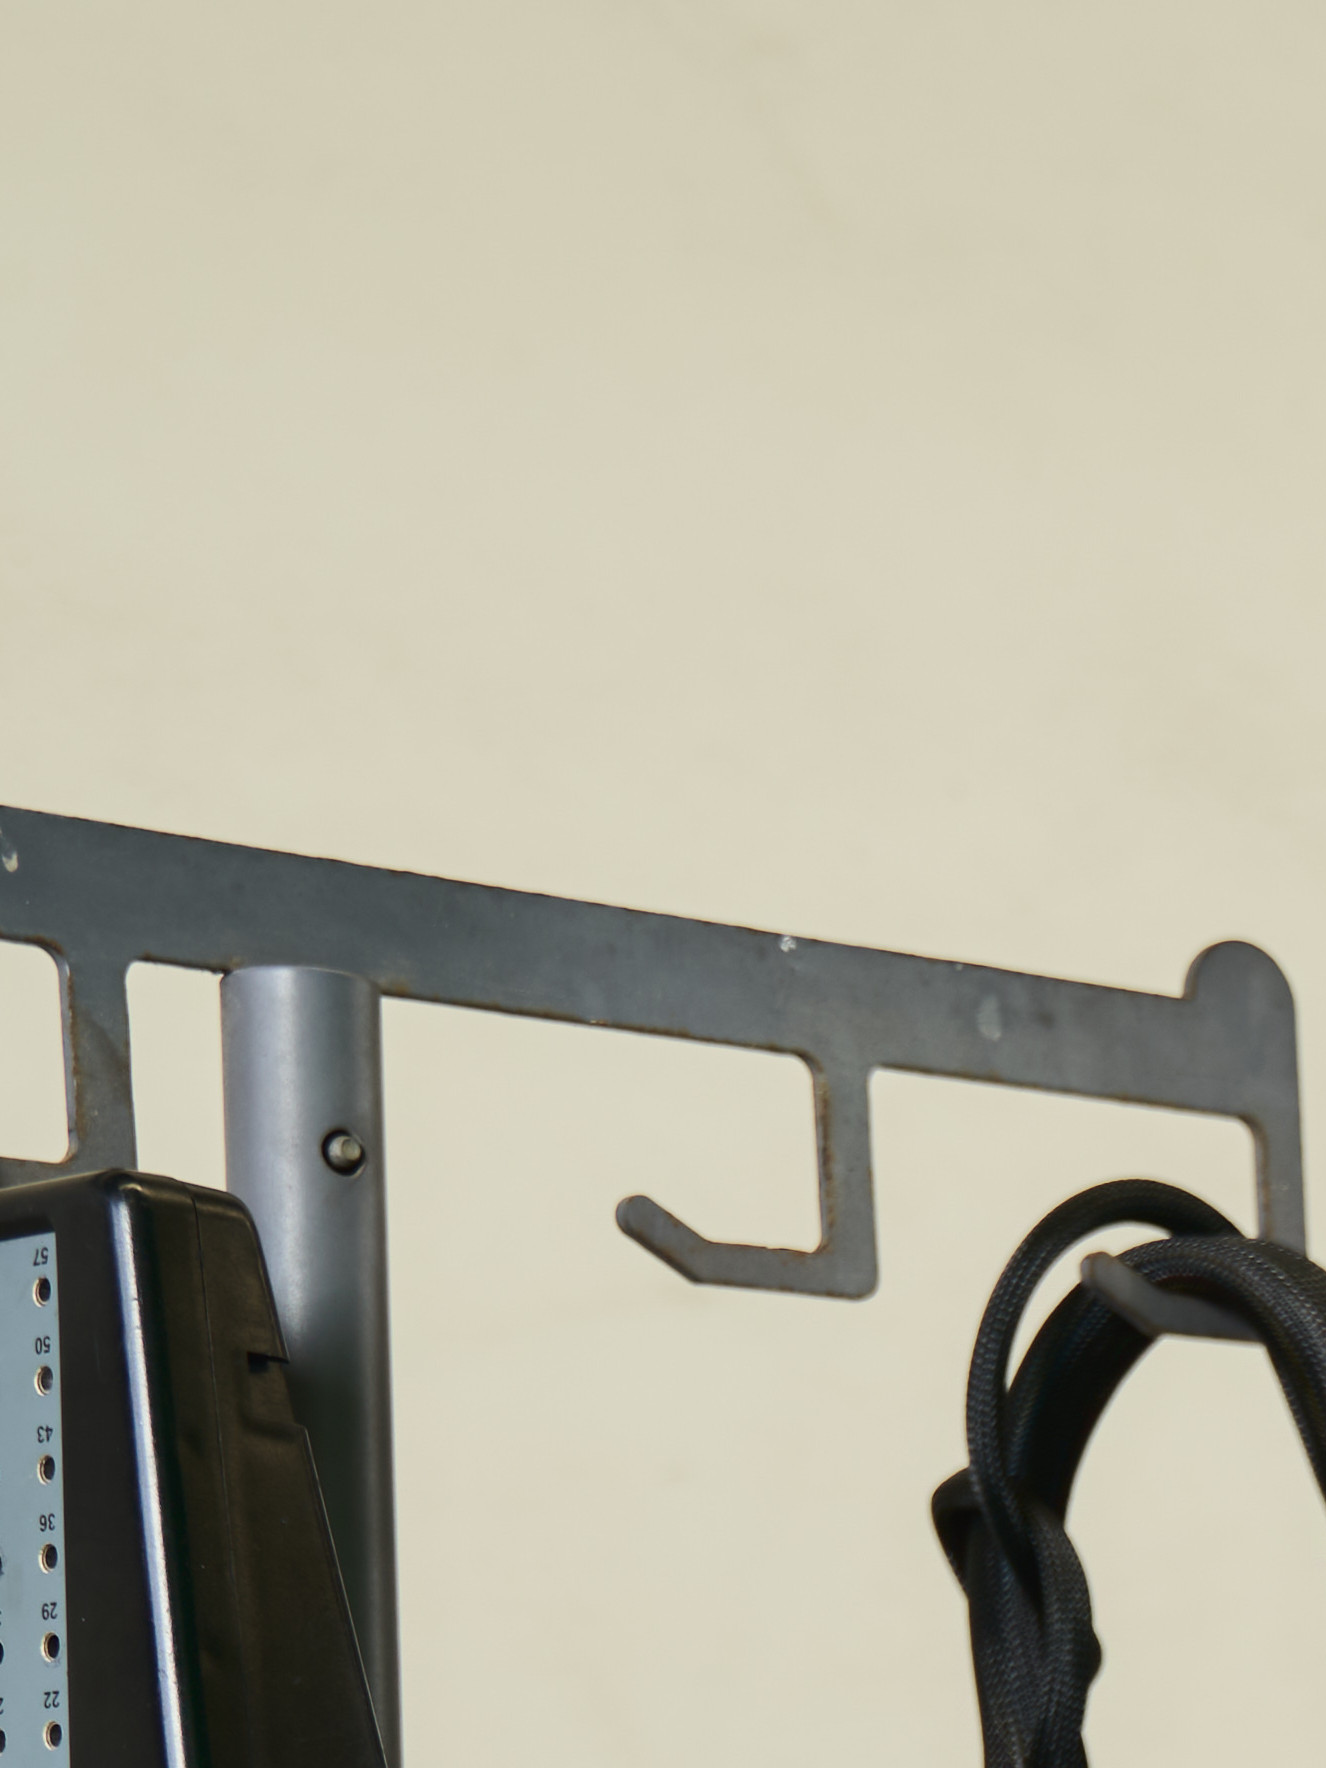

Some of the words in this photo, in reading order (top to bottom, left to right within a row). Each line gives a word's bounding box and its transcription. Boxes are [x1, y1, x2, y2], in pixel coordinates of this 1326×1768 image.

[33, 1247, 49, 1266] 57
[35, 1336, 51, 1355] 50
[36, 1425, 53, 1443] 43
[39, 1513, 56, 1531] 36
[41, 1602, 58, 1620] 29
[44, 1691, 60, 1709] 22
